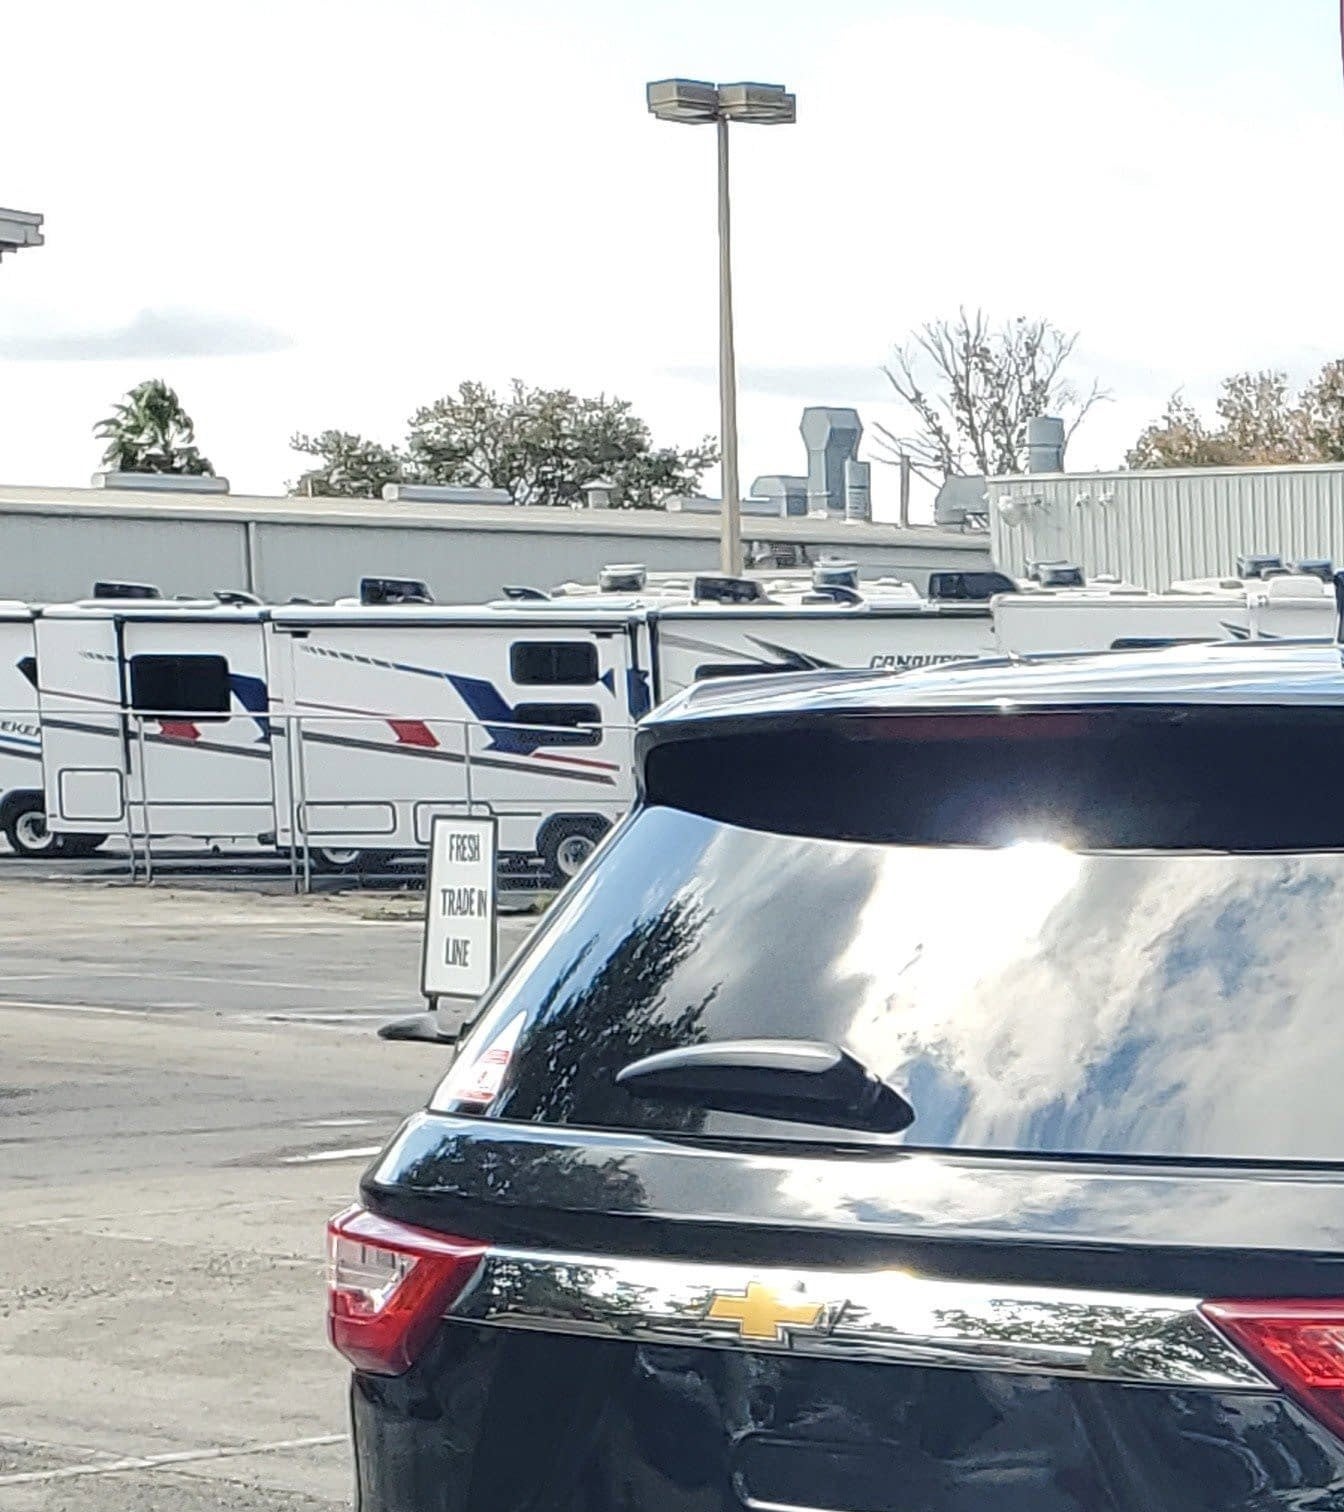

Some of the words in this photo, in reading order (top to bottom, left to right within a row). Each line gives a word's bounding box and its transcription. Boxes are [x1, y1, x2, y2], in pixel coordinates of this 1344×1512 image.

[870, 655, 979, 671] CONQU
[449, 834, 480, 862] FRESH
[441, 888, 475, 917] TRADE
[477, 890, 488, 918] IN
[445, 937, 470, 967] LINE
